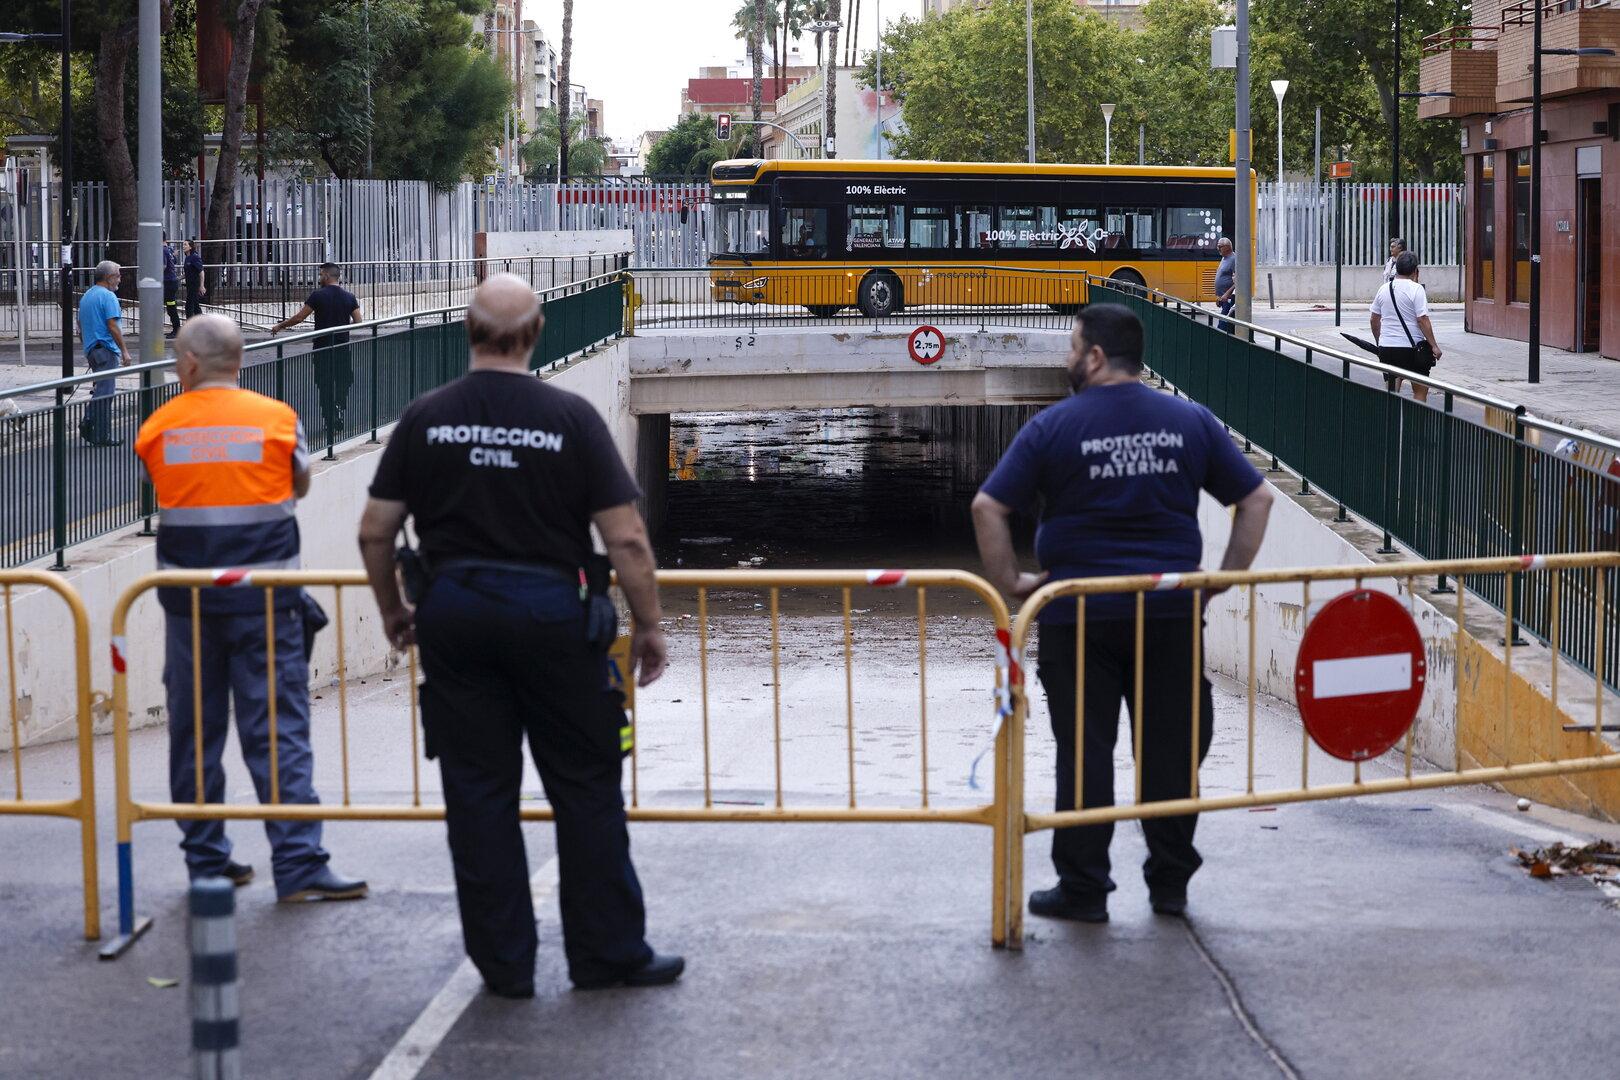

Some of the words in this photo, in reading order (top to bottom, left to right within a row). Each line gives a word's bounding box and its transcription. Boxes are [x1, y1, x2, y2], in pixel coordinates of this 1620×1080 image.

[846, 185, 872, 195] 100%
[873, 185, 907, 195] Elèctric
[985, 230, 1017, 241] 100%
[1019, 230, 1060, 241] Elèctric
[426, 424, 563, 453] PROTECCION
[1080, 429, 1184, 456] PROTECCIÓN
[469, 446, 520, 469] CIVIL
[1110, 447, 1157, 464] CIVIL
[1089, 458, 1179, 480] PATERNA
